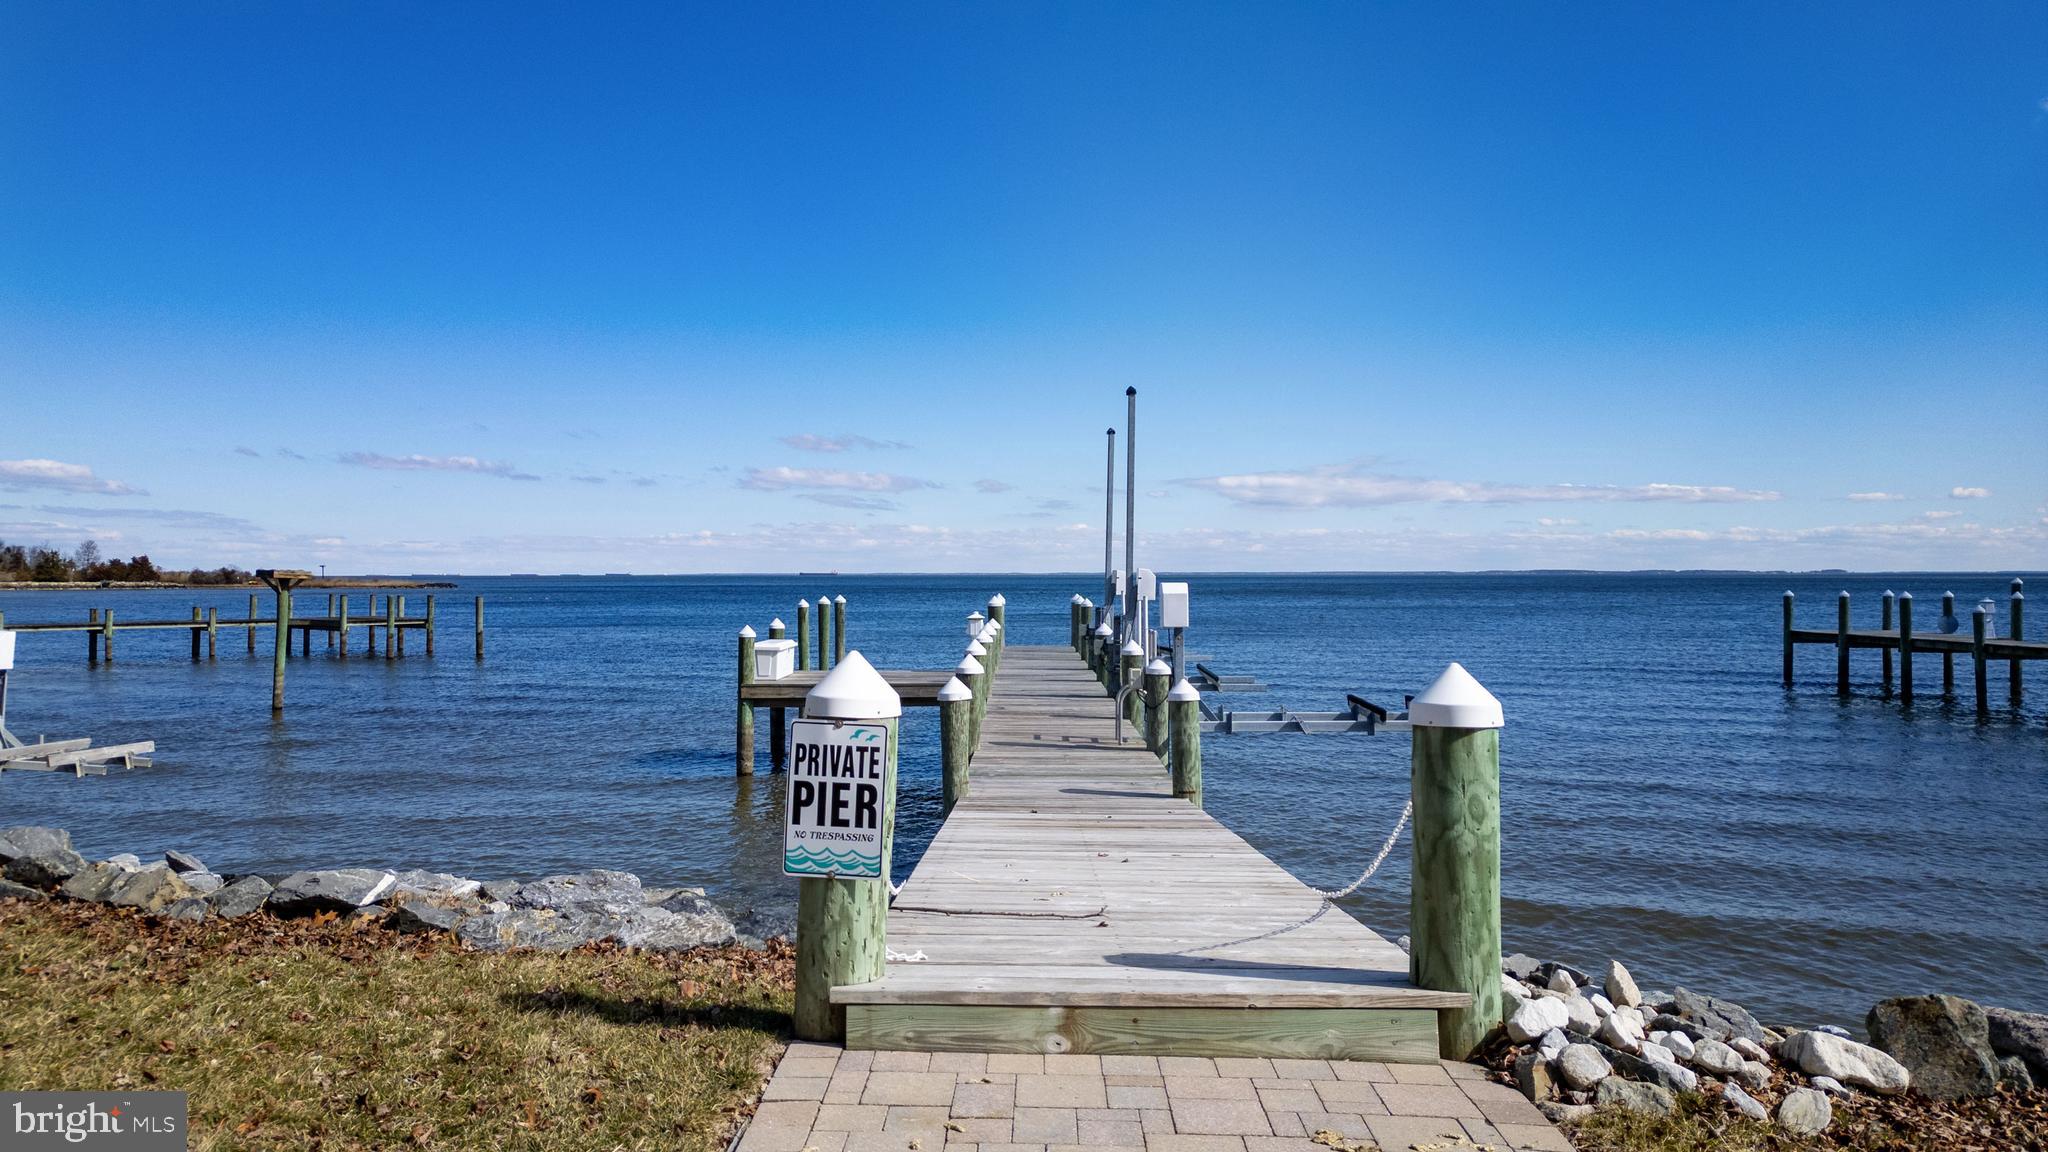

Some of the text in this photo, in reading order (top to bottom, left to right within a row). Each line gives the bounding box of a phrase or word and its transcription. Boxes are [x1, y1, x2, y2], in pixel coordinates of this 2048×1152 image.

[794, 743, 881, 779] PRIVATE
[791, 780, 878, 829] PIER
[793, 830, 874, 842] NO TRESPASSING
